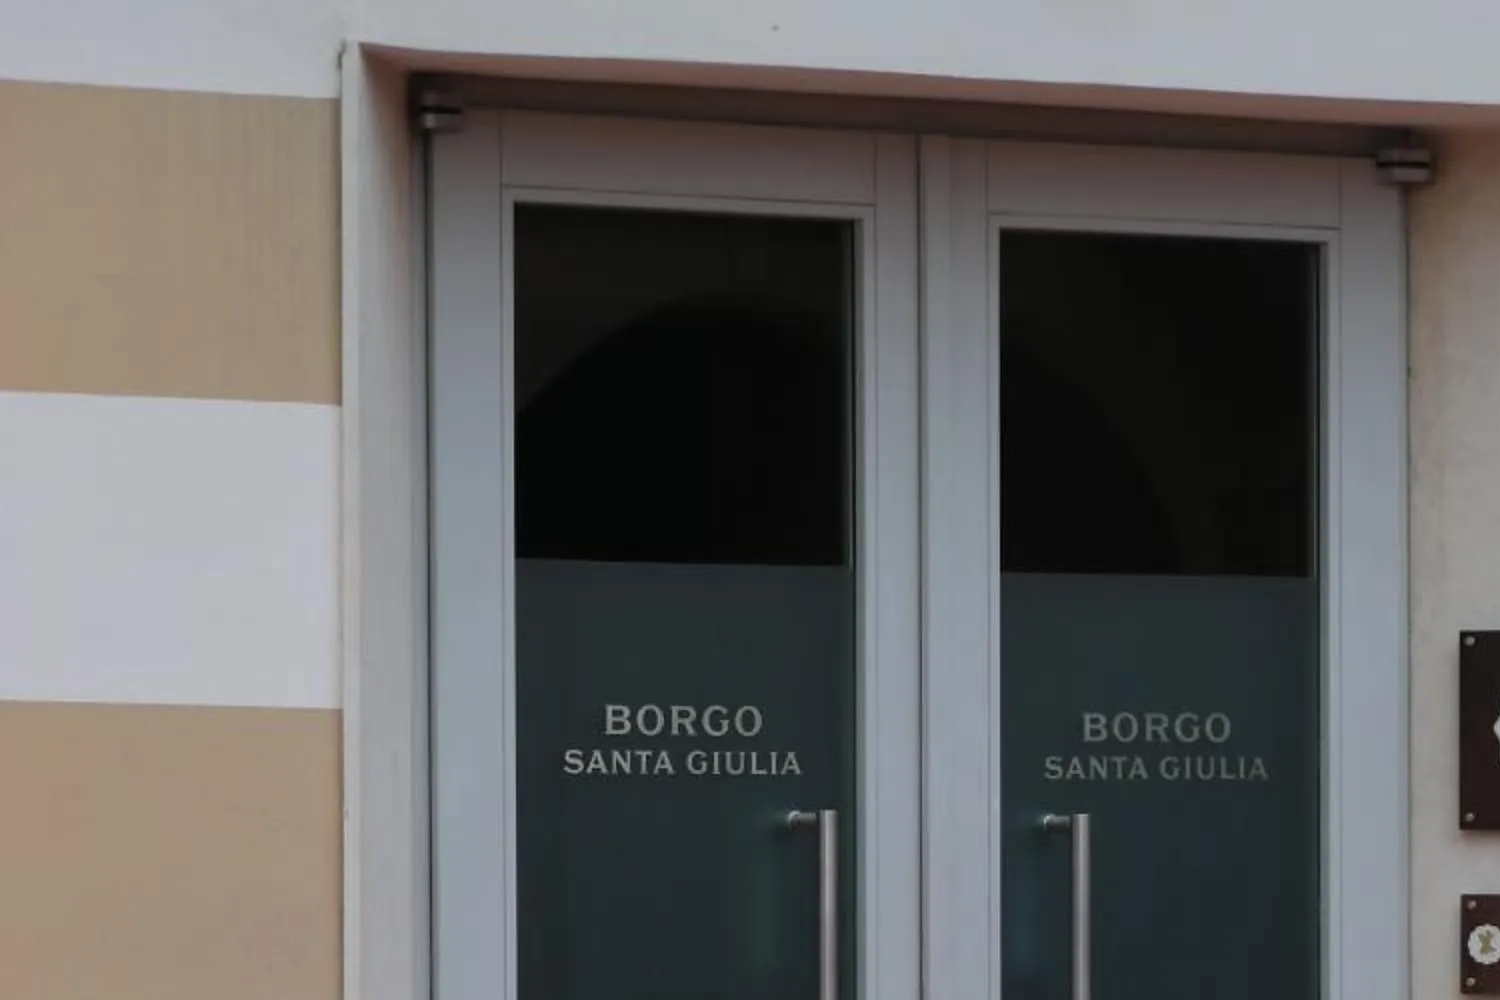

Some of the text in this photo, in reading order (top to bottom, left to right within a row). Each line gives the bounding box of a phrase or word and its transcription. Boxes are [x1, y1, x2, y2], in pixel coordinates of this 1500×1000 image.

[604, 703, 763, 737] BORGO
[1082, 711, 1232, 743] BORGO
[563, 749, 801, 776] SANTA GIULIA
[1044, 756, 1269, 781] SANTA GIULIA
